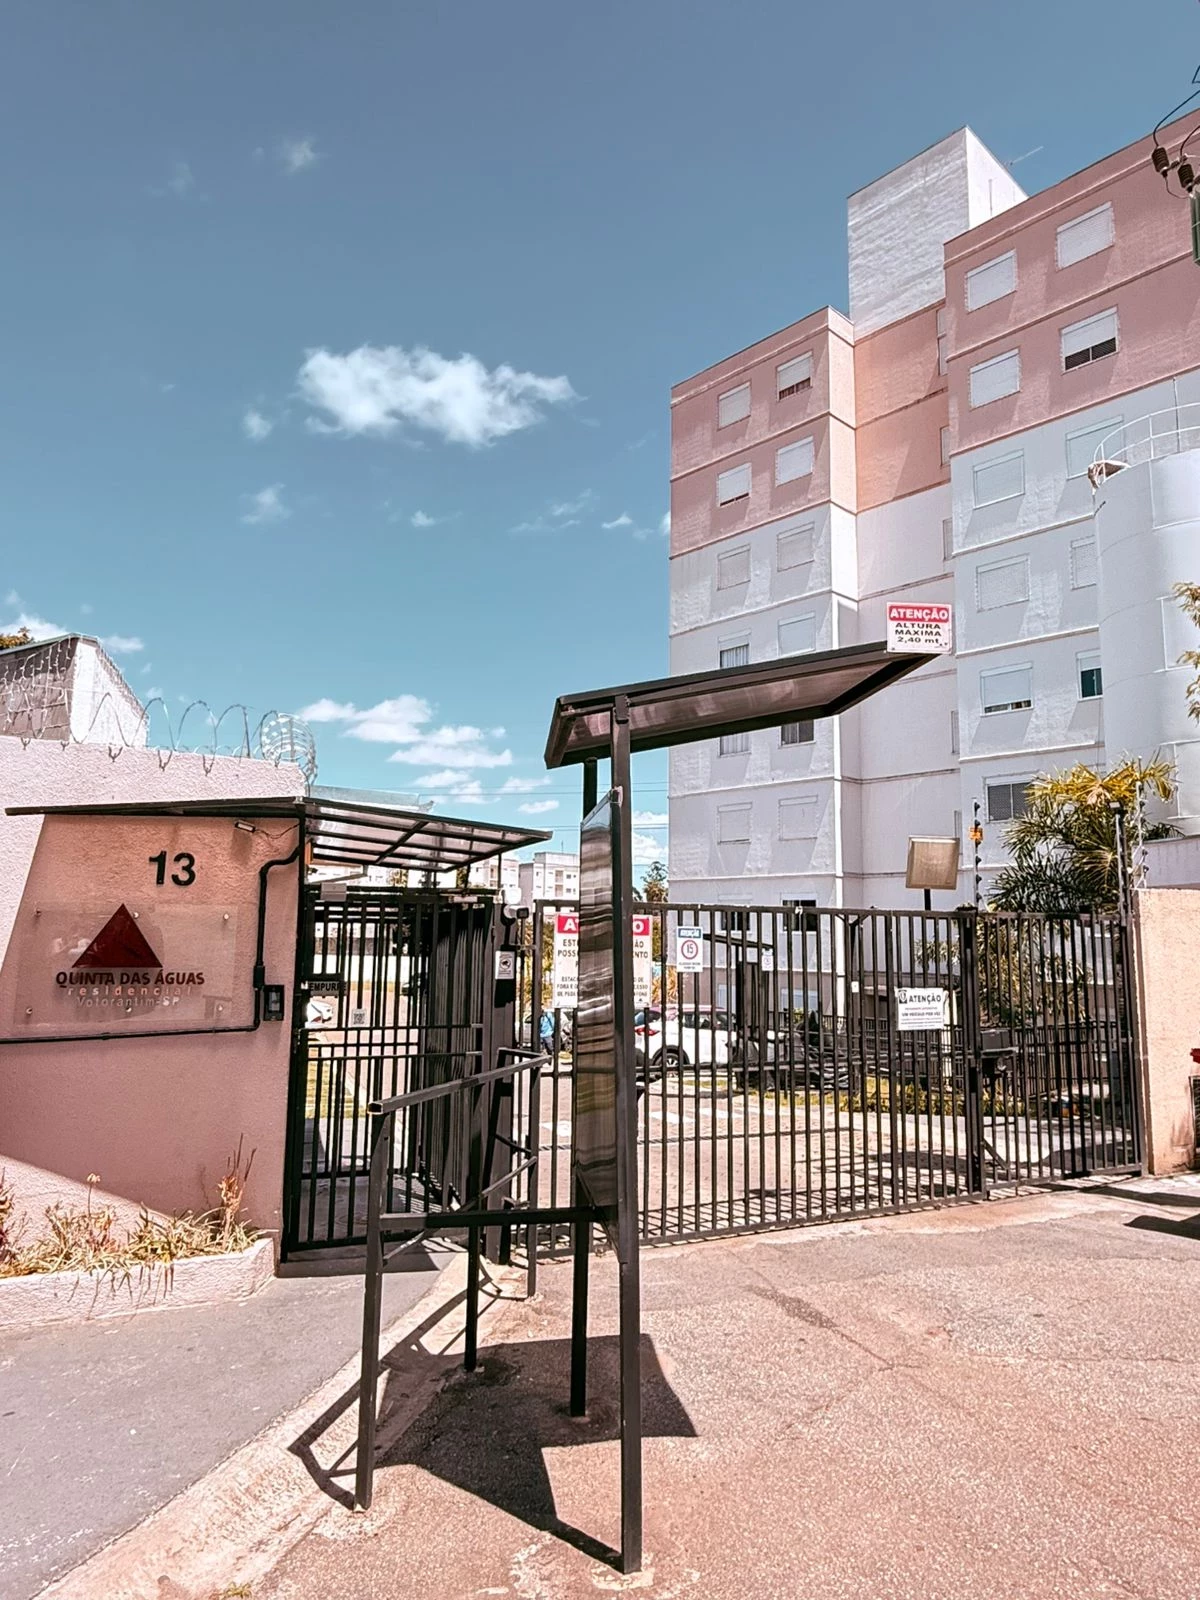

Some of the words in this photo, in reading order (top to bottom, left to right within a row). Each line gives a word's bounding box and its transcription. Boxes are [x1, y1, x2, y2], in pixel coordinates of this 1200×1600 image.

[890, 608, 948, 621] ATENÇÃO
[148, 850, 196, 887] 13
[686, 944, 694, 954] 15
[56, 971, 116, 988] QUINTA
[120, 971, 150, 986] DAS
[154, 969, 205, 985] ÁGUAS
[67, 985, 192, 996] residencial
[909, 993, 941, 1004] ATENÇÃO
